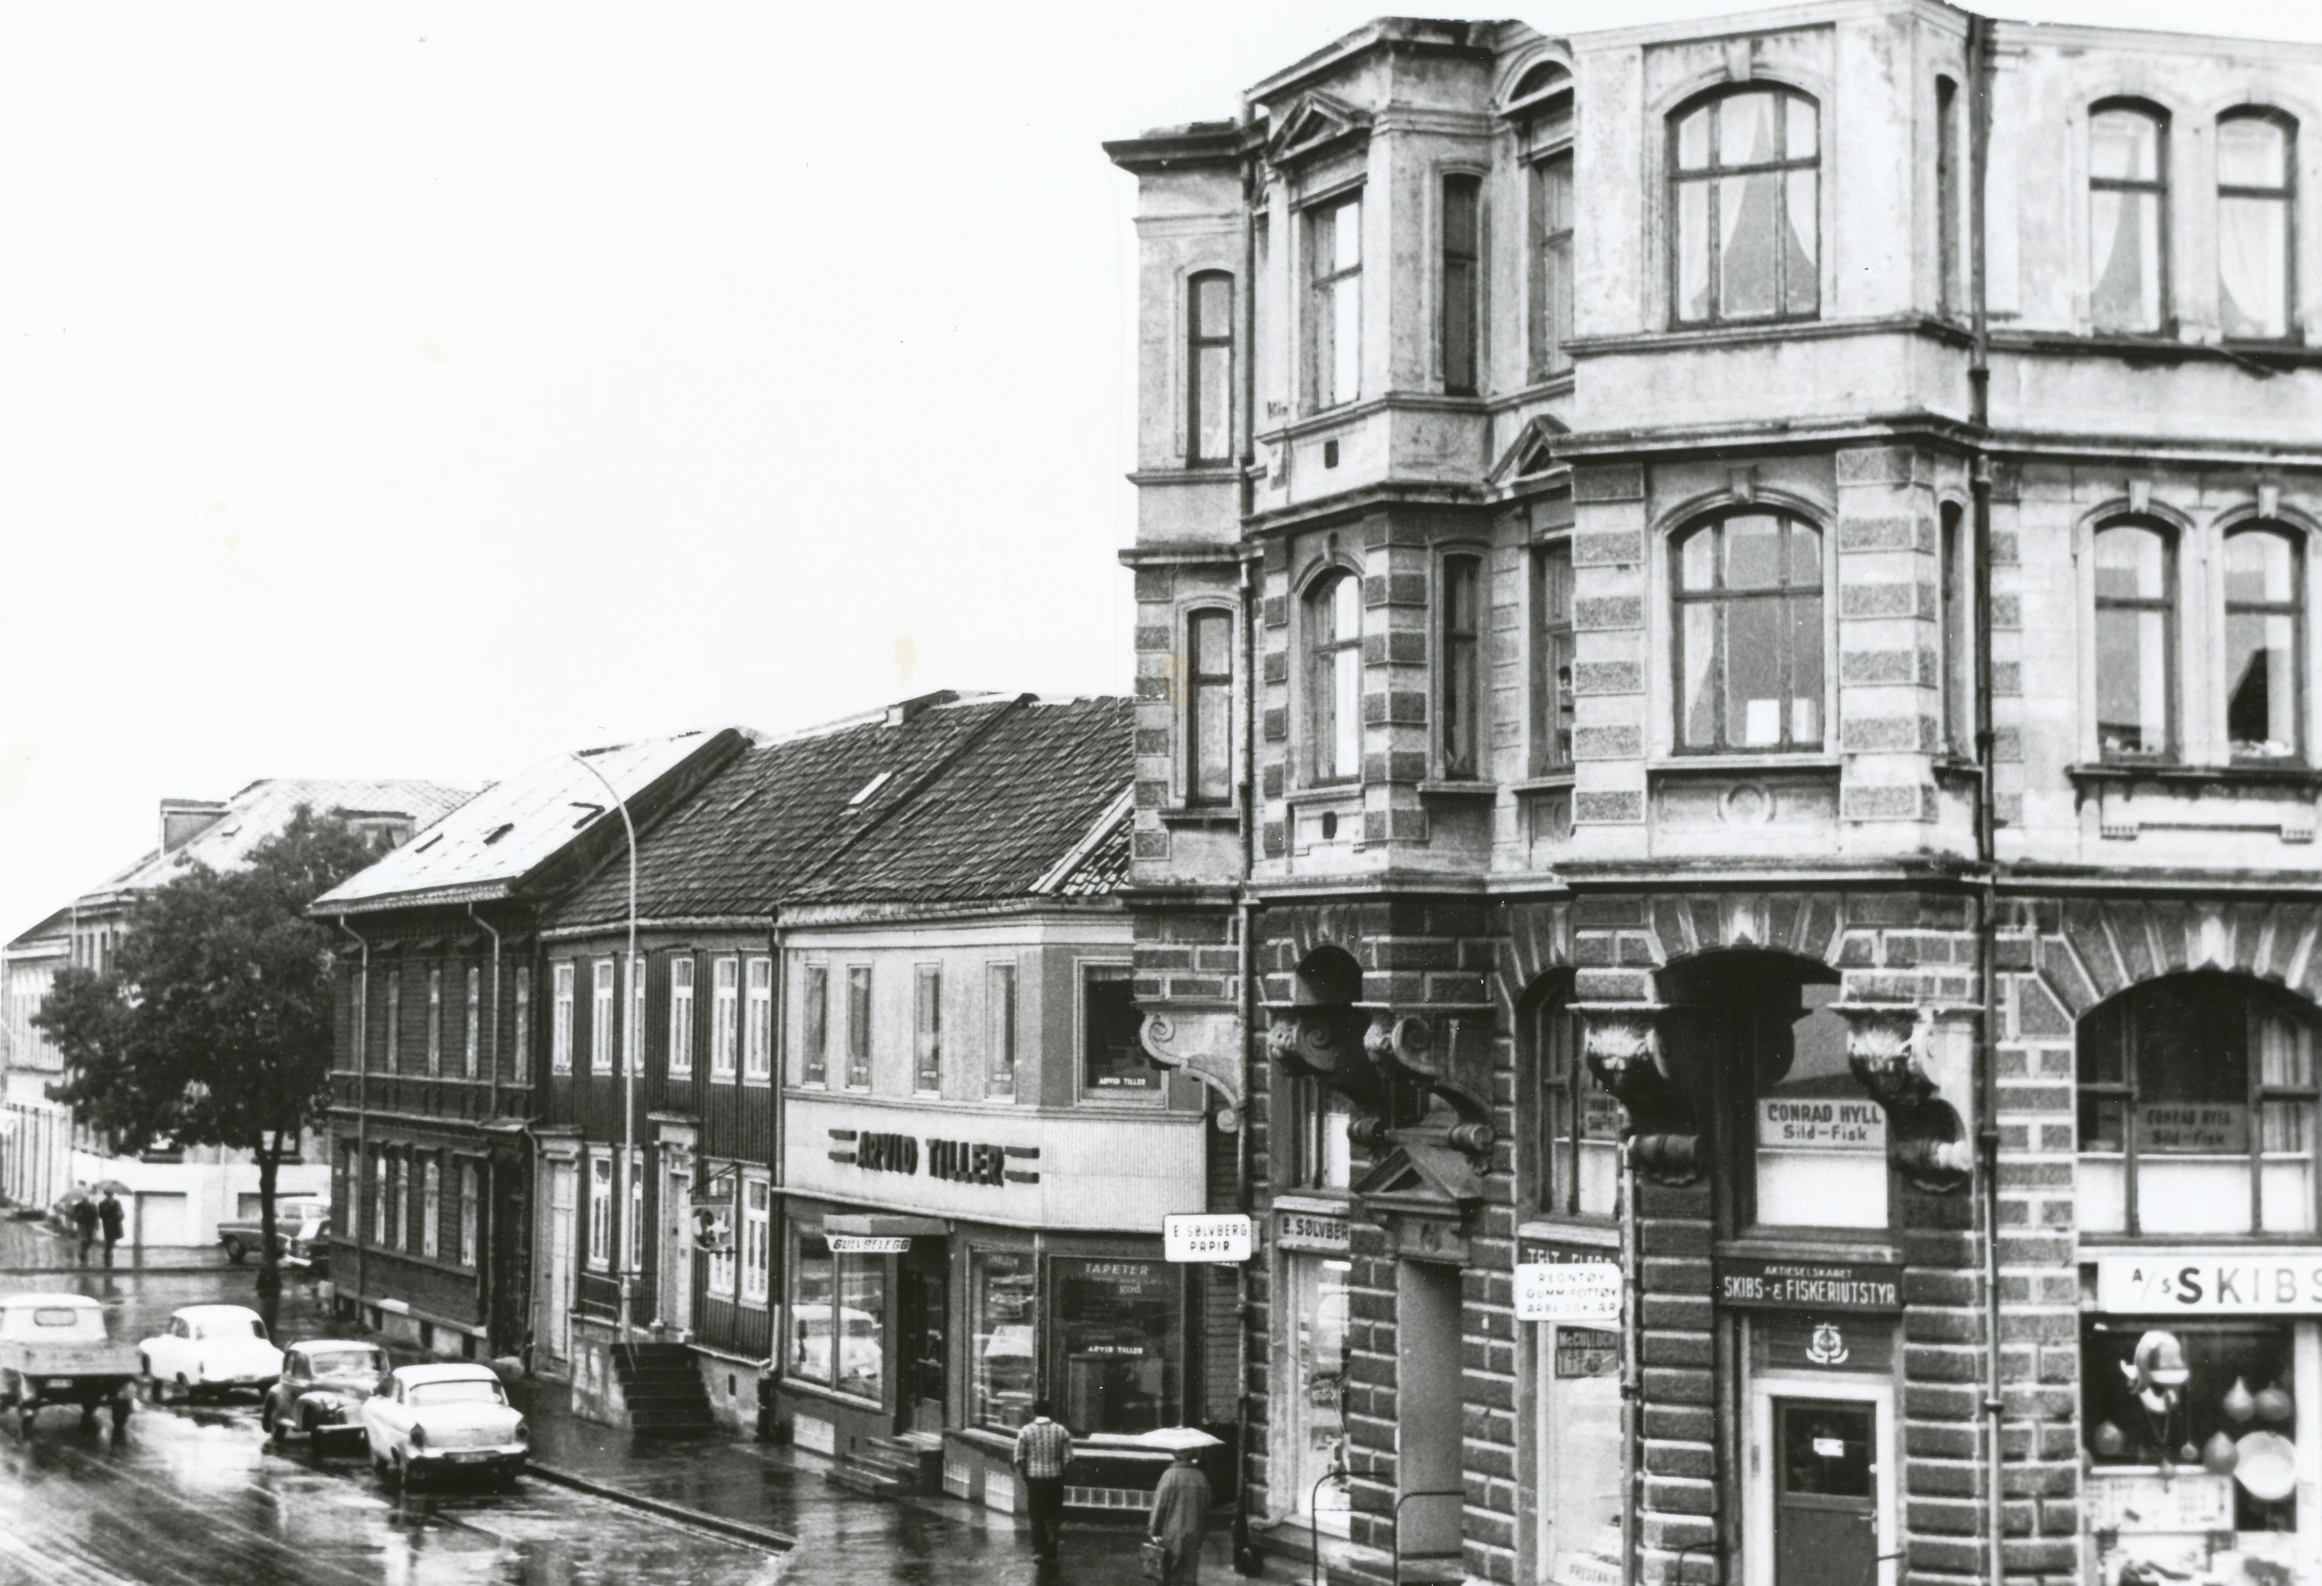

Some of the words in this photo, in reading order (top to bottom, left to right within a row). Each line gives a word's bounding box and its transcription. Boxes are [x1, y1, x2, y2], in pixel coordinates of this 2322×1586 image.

[1767, 1104, 1833, 1122] CONRAD
[1840, 1105, 1881, 1124] HYLL
[2147, 1109, 2196, 1125] CONRAD
[857, 1131, 918, 1176] ARVID
[926, 1139, 1005, 1188] TILLER
[1187, 1224, 1247, 1237] SØLVBERG
[1296, 1218, 1350, 1241] SØLVBER
[1190, 1241, 1230, 1252] PAPIR
[1085, 1263, 1149, 1276] TAPETER
[1764, 1266, 1853, 1278] AKTIESELSKABET
[1786, 1279, 1896, 1305] FISKERIUTSTYR
[1527, 1302, 1616, 1313] ARBEDSKÆR
